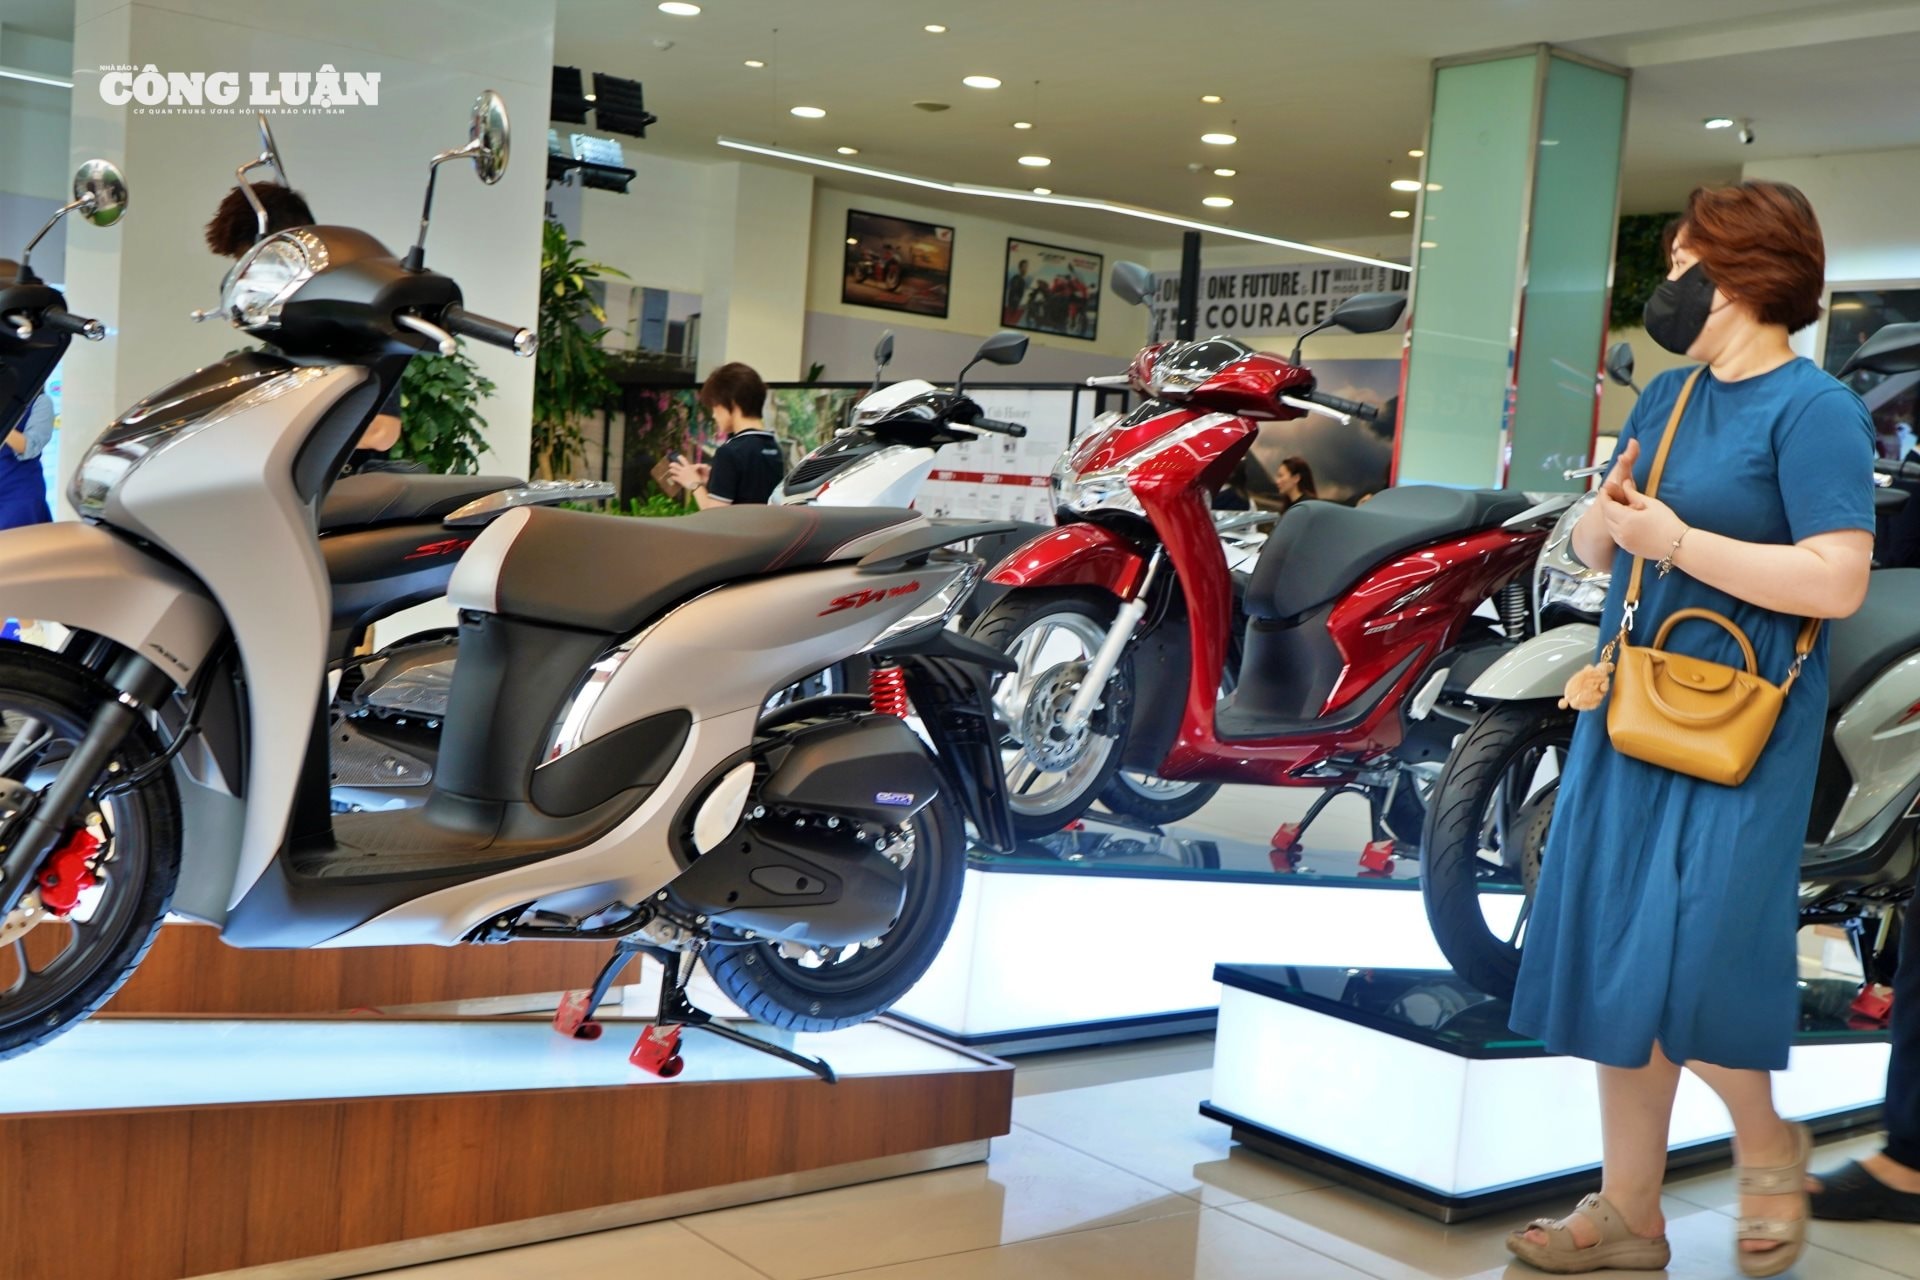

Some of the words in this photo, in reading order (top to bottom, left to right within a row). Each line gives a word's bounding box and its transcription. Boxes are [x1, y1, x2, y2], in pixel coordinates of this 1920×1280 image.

[1207, 275, 1237, 299] ONE
[1311, 269, 1330, 294] IT
[1334, 268, 1358, 281] WILL
[1362, 266, 1375, 280] BE
[1205, 301, 1327, 329] COURAGE
